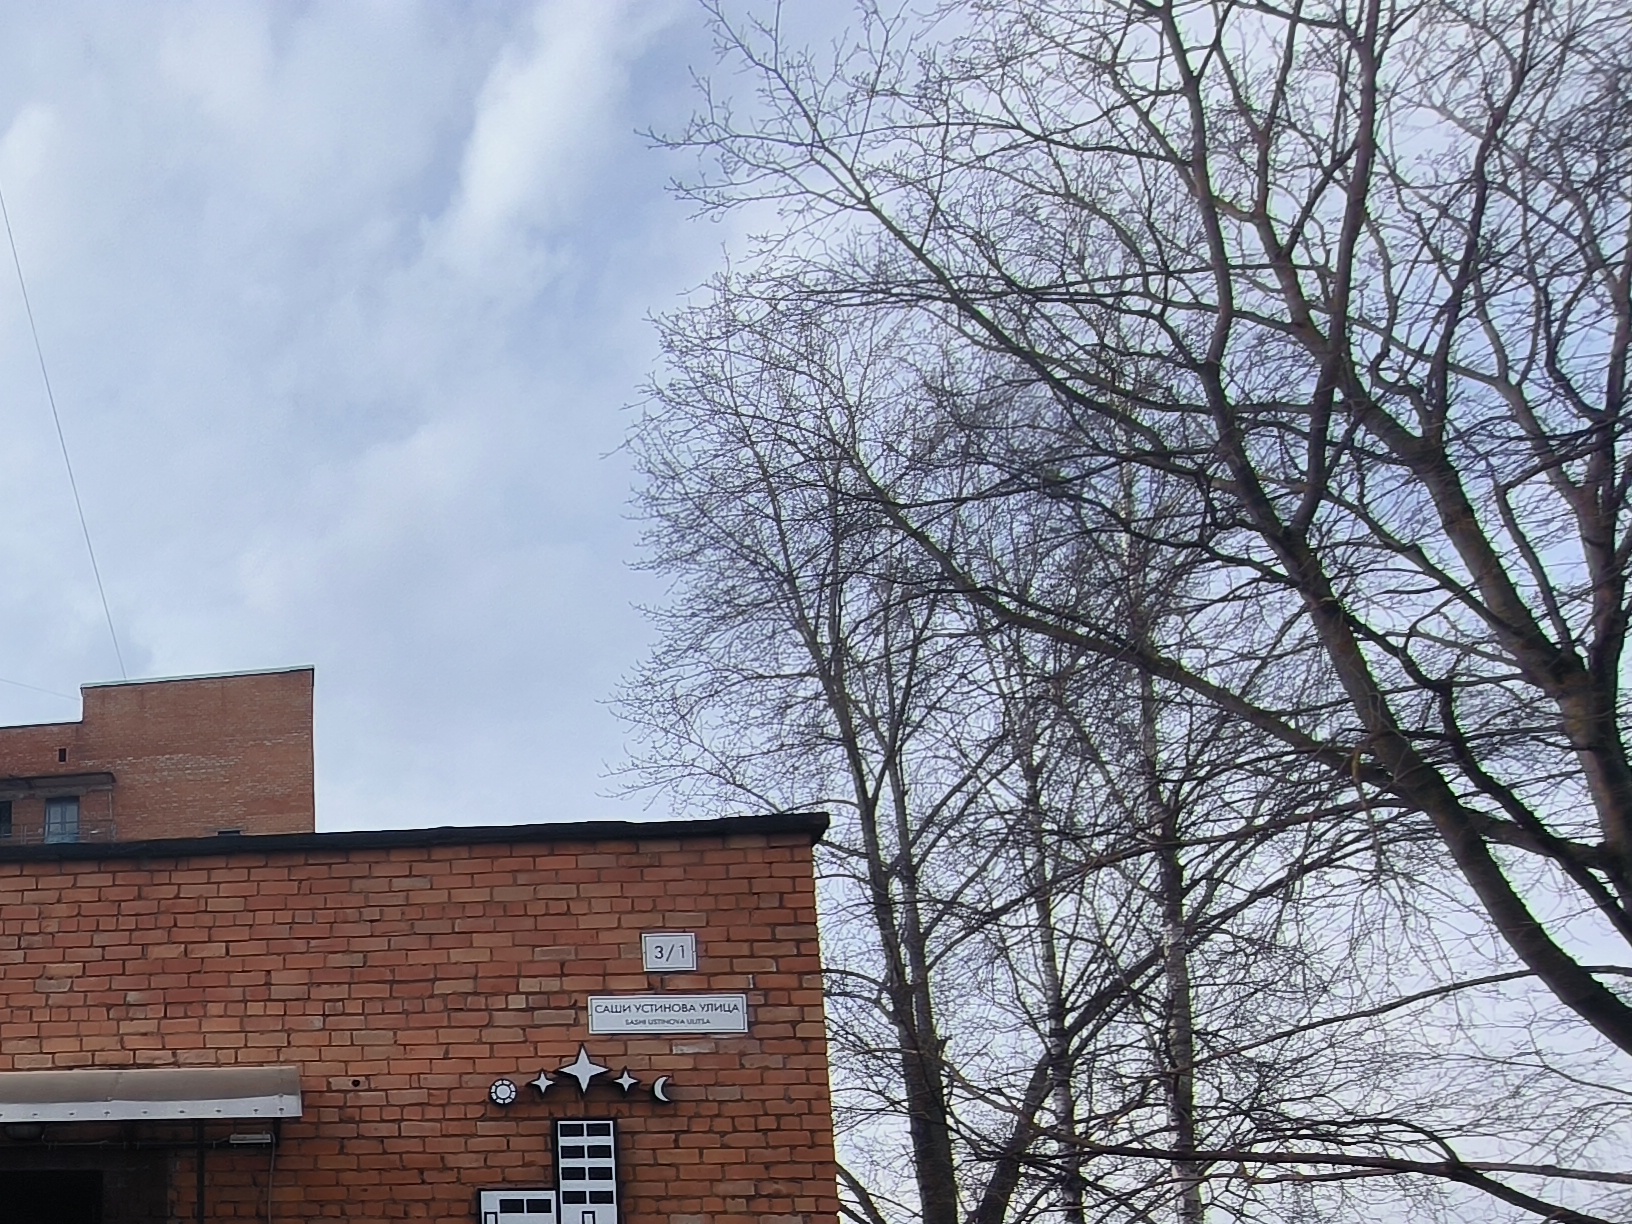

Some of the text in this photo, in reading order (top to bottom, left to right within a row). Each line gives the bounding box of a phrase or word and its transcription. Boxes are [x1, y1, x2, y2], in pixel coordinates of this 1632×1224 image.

[654, 944, 685, 962] 3/1
[594, 1003, 740, 1014] САШИ УСТИНОВА УЛИЦА
